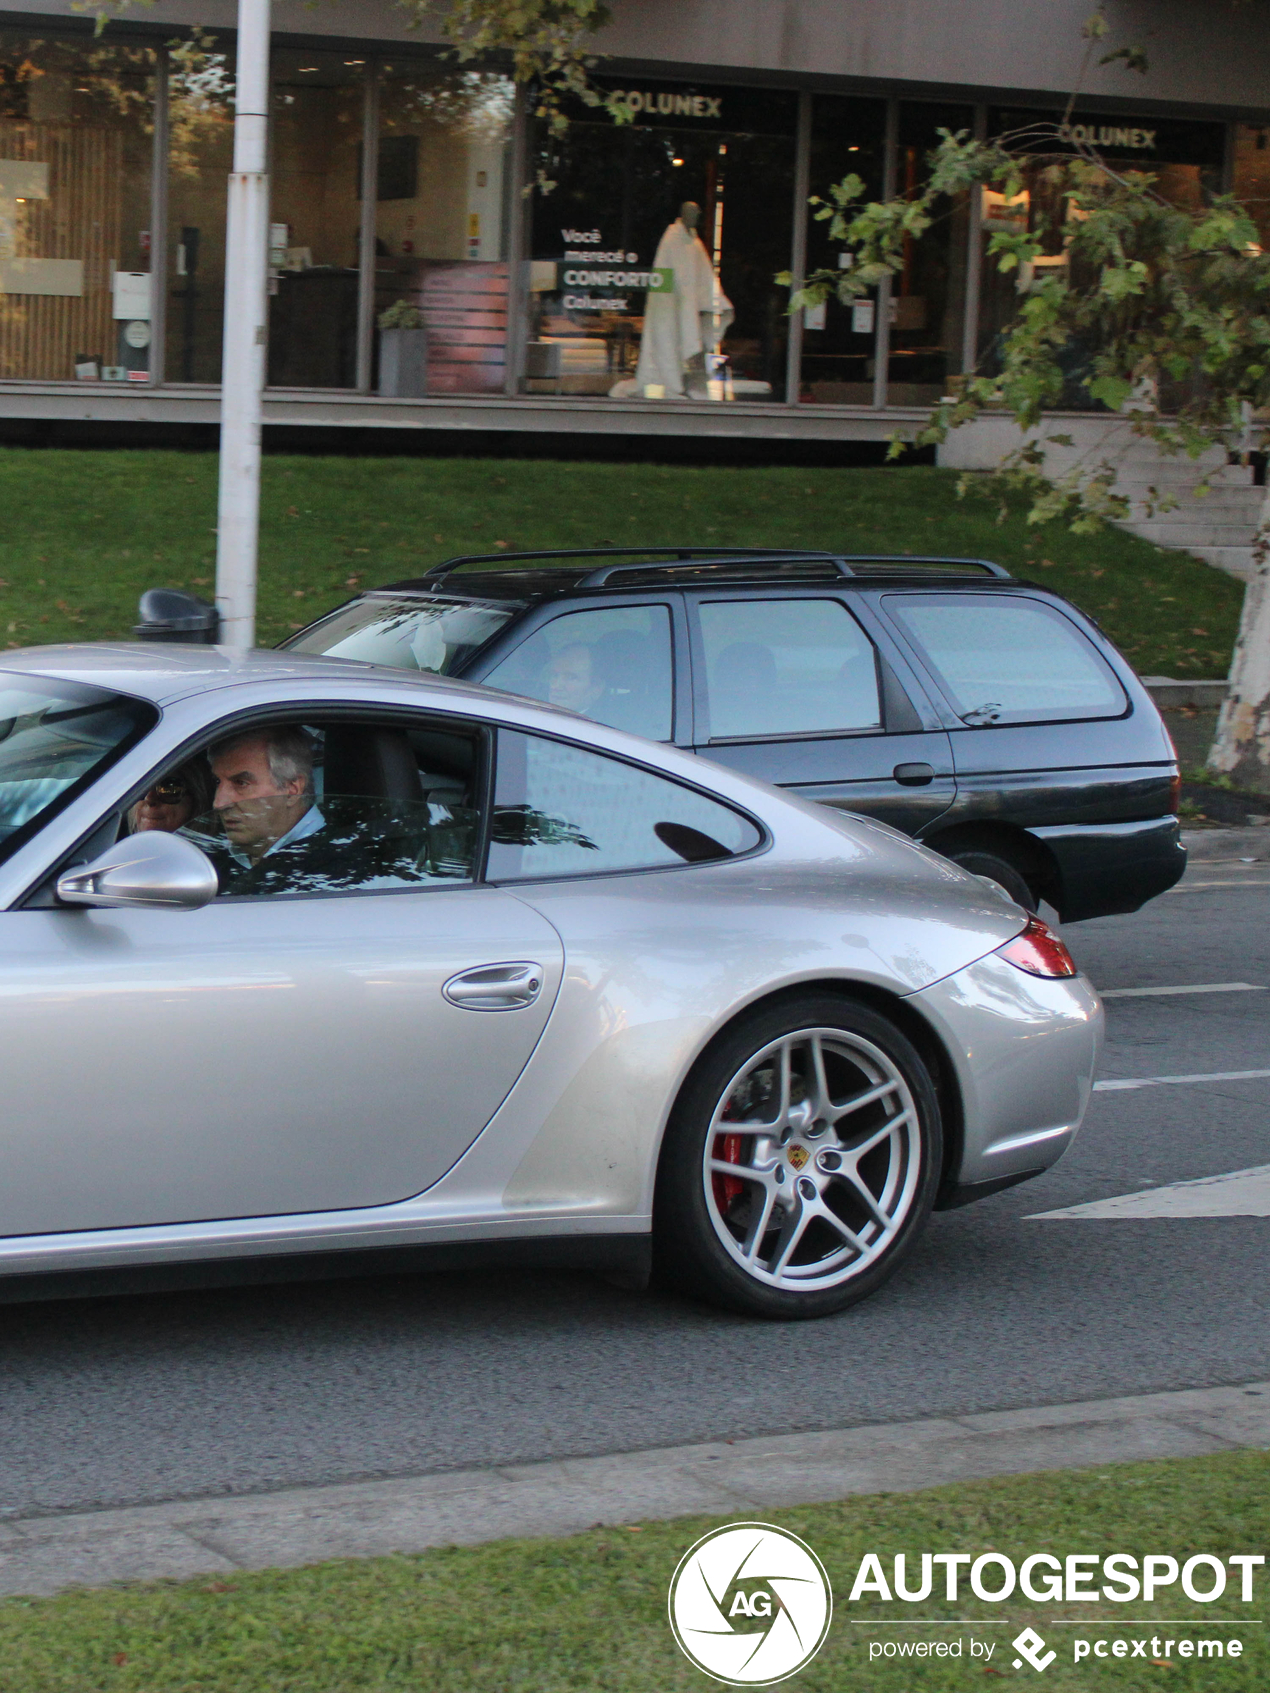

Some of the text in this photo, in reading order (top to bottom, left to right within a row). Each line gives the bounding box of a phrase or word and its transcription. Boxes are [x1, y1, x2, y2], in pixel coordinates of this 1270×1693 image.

[561, 228, 602, 243] Você
[564, 251, 639, 264] merece o
[564, 270, 663, 288] CONFORTO
[563, 295, 628, 310] Colunex
